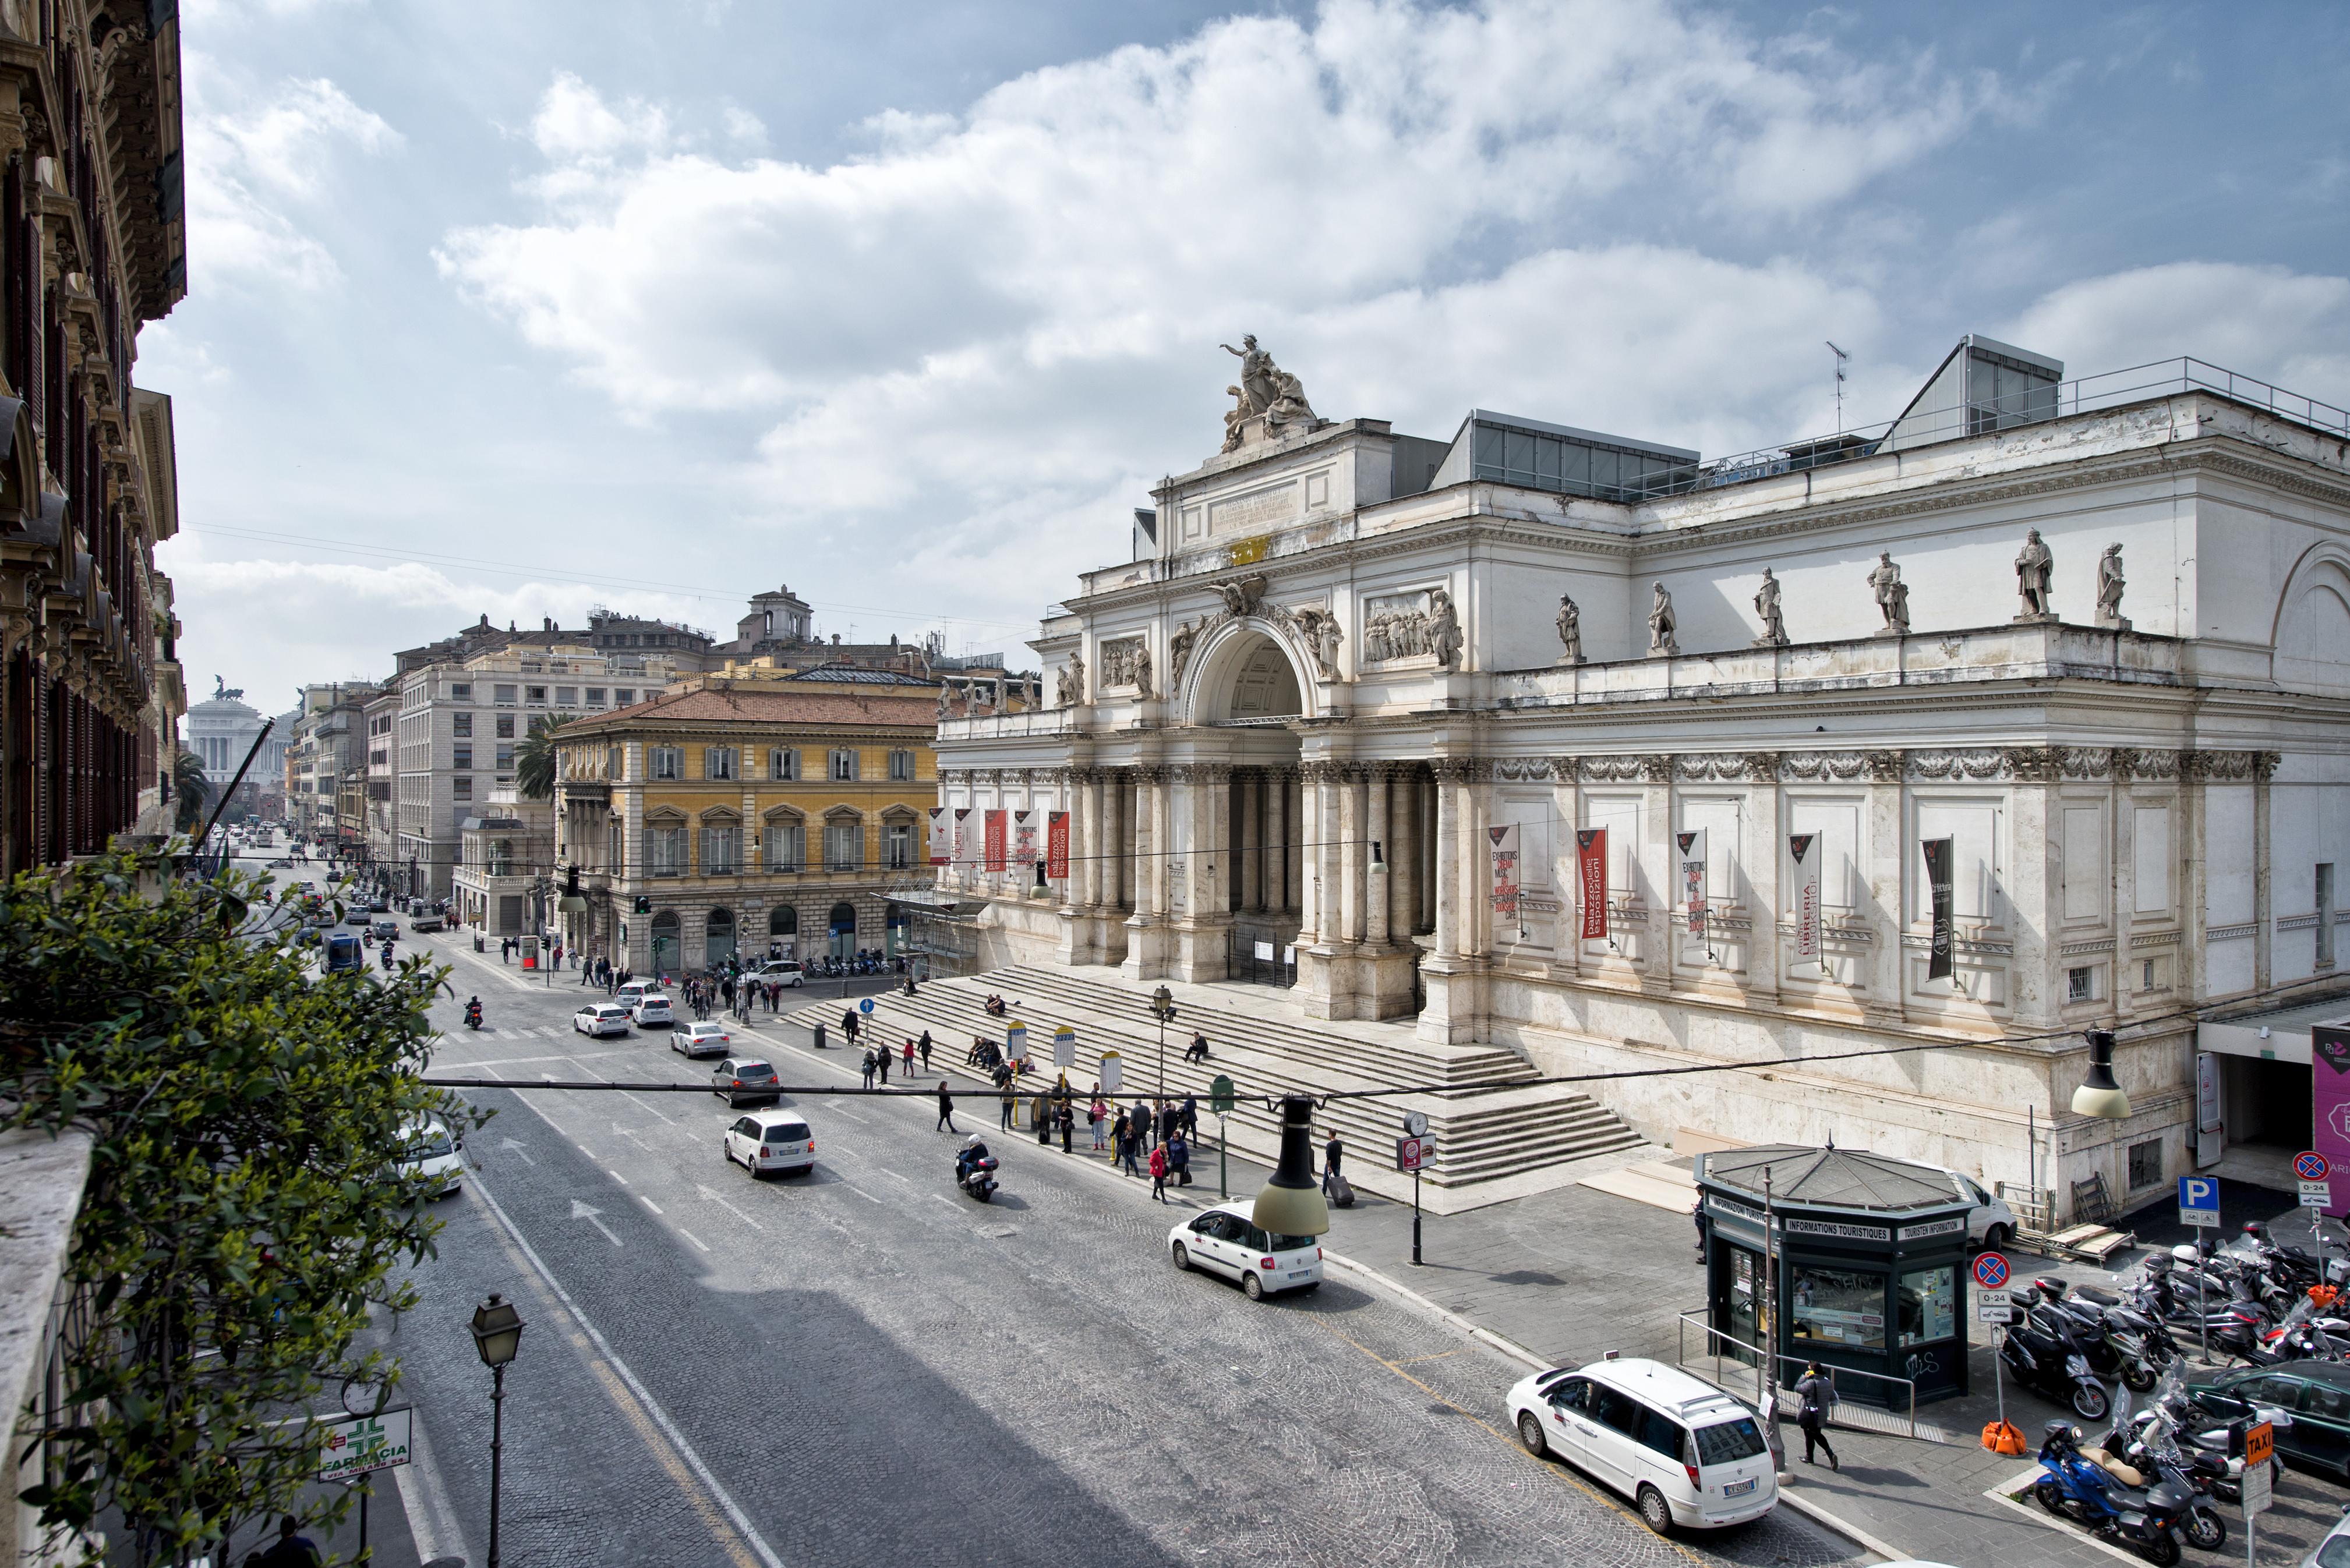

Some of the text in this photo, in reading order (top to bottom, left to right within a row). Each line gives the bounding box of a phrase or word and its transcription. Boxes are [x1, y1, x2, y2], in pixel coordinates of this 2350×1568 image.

[1225, 505, 1244, 514] COMUNE
[1227, 508, 1253, 518] ESPOSIZIONE
[1268, 504, 1292, 513] PROVINCIA
[1493, 851, 1518, 861] EXHIBITIONS
[1497, 859, 1513, 869] CINEMA
[1683, 861, 1705, 873] EXHIBITIONS
[1495, 868, 1508, 878] MUSIC
[1688, 870, 1702, 882] CINEMA
[1494, 885, 1518, 895] WORKSHOPS
[1687, 882, 1698, 892] MUSIC
[1494, 893, 1518, 904] RESTAURANT
[1593, 858, 1602, 933] esposizioni
[1496, 902, 1515, 912] BOOKSHOP
[2186, 1180, 2210, 1205] P
[1714, 1197, 1744, 1216] INFORMAZIONI
[1790, 1220, 1886, 1240] INFORMATIONS TOURISTIQUES
[1904, 1220, 1957, 1238] TOURISTEN INFORMATION
[2248, 1431, 2271, 1455] TAXI
[349, 1462, 386, 1474] MILANO
